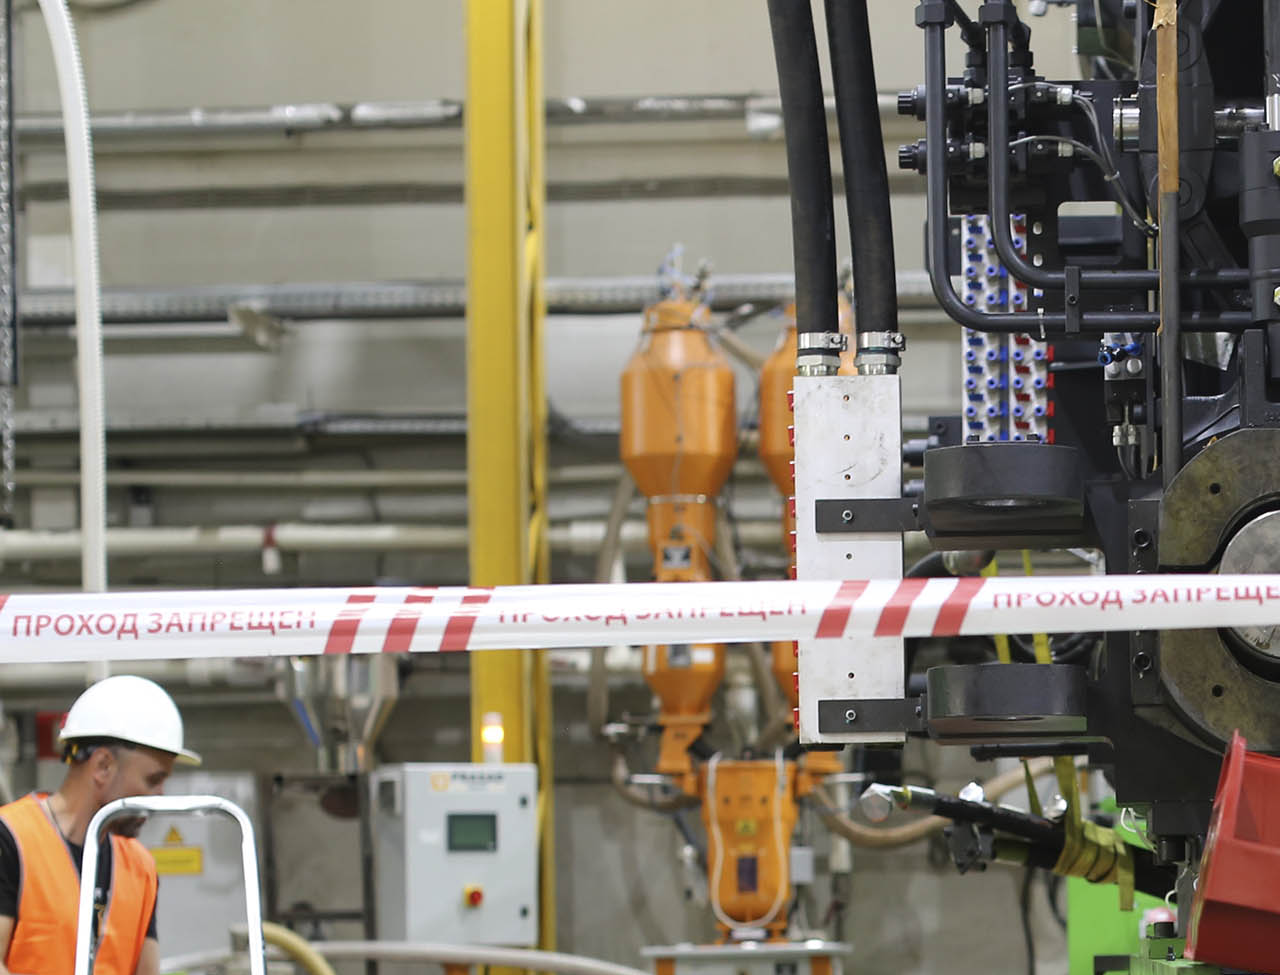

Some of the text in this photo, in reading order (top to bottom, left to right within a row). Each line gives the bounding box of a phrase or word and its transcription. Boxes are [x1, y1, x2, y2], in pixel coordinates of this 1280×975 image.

[993, 590, 1123, 611] ПРОХОД
[12, 610, 316, 640] ПРОХОД ЗАПРЕЩЕН
